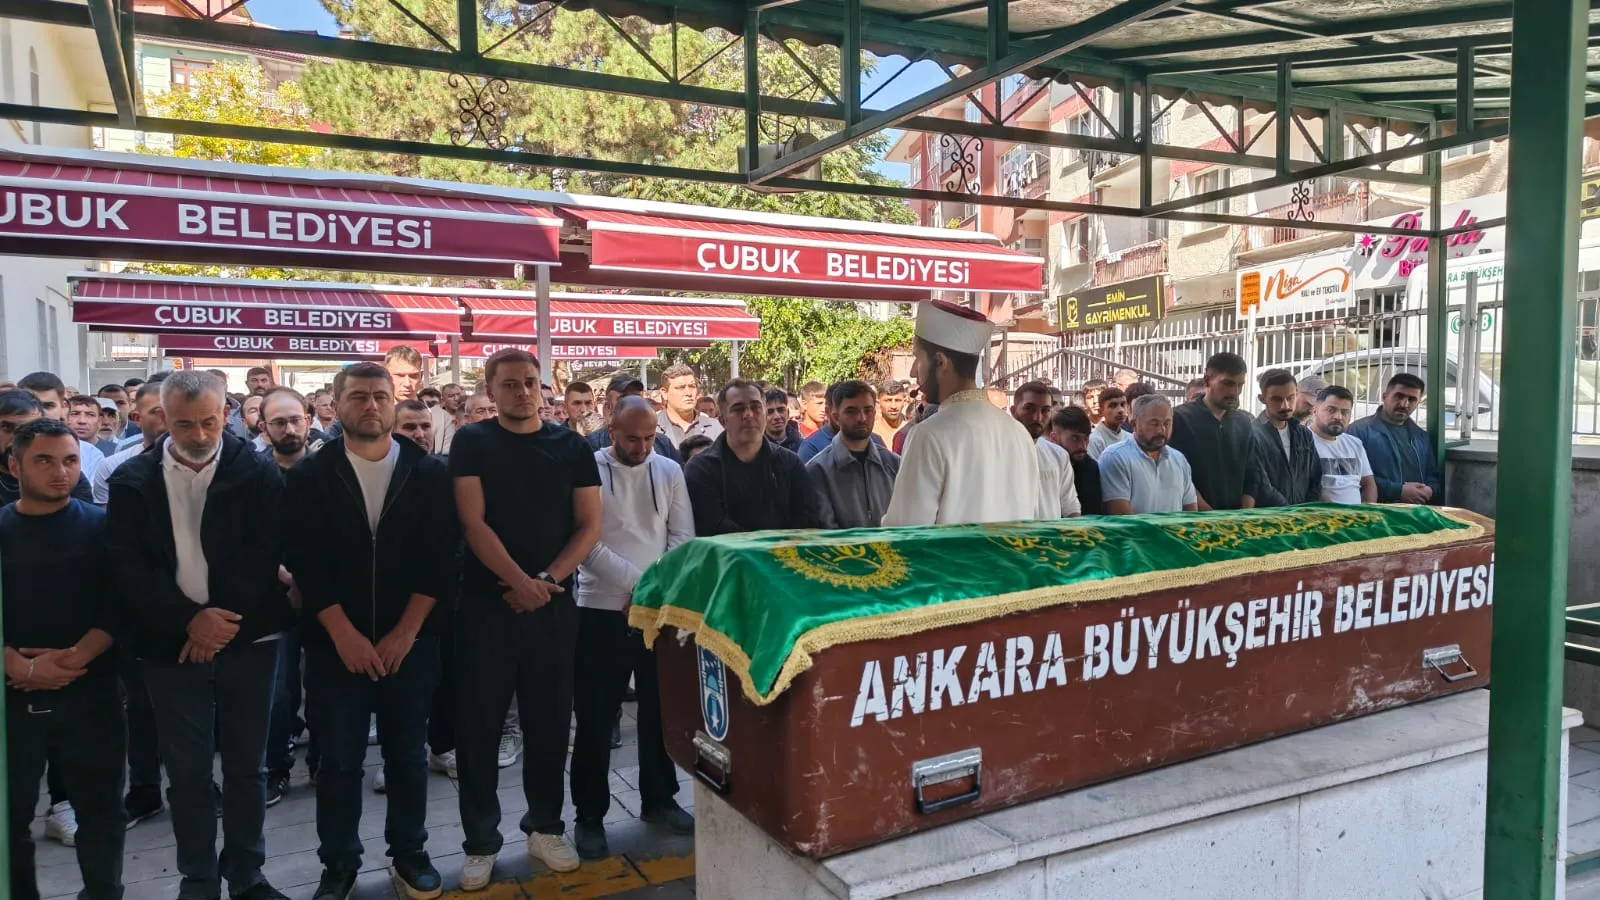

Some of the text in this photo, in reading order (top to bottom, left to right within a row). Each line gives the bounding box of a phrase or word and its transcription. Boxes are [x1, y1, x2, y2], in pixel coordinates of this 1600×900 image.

[697, 243, 801, 273] ÇUBUK
[1106, 289, 1125, 304] EMİN
[154, 306, 242, 325] ÇUBUK
[1085, 304, 1151, 325] GAYRİMENKUL
[213, 336, 274, 350] ÇUBUK
[850, 552, 1495, 727] ANKARA BÜYÜKŞEHİR BELEDİYESİ
